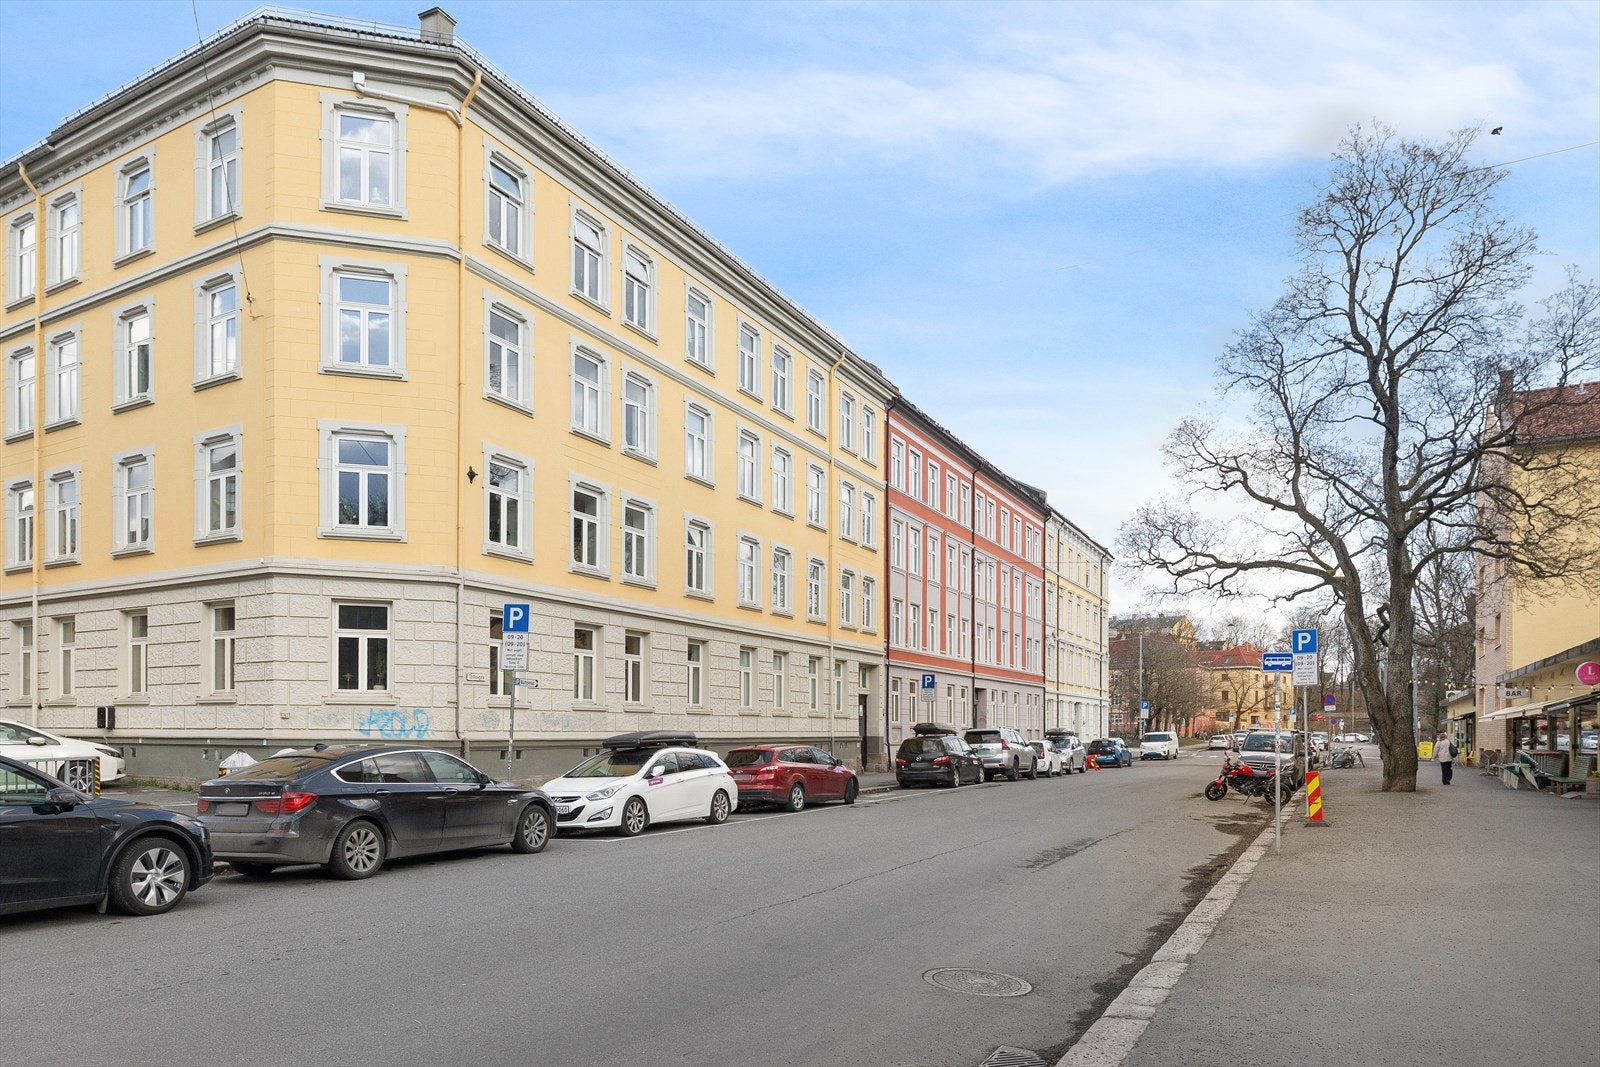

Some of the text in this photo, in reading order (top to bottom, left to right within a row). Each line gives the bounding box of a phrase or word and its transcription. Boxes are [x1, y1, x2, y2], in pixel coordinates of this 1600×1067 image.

[509, 607, 523, 629] P
[1297, 632, 1311, 651] P
[925, 675, 932, 687] P
